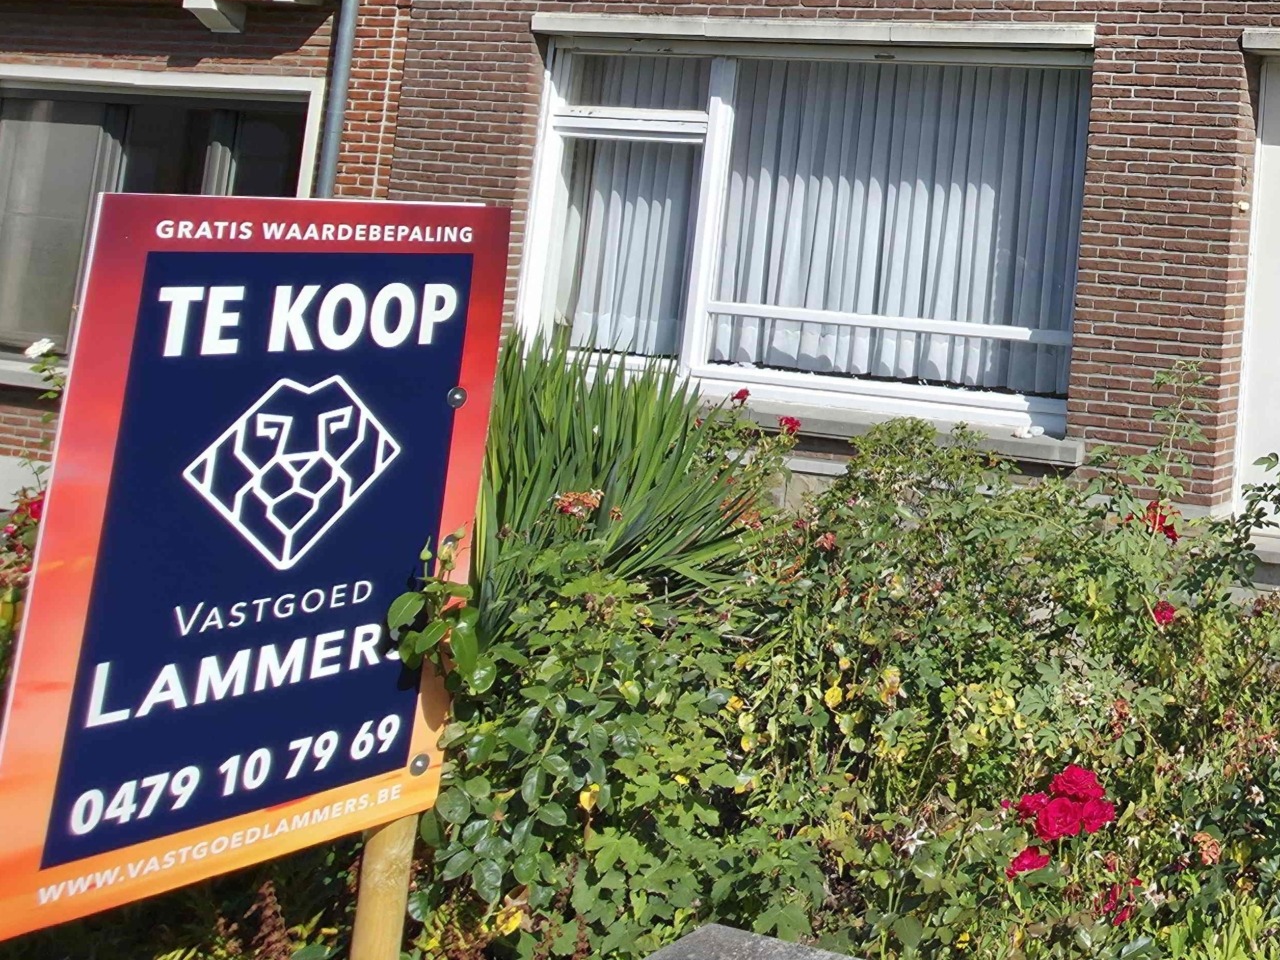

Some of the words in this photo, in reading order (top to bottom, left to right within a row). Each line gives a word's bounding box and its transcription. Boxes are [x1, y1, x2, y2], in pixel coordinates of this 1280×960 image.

[155, 220, 253, 239] GRATIS
[262, 222, 474, 243] WAARDEBEPALING
[158, 286, 245, 357] TE
[267, 282, 458, 352] KOOP
[174, 580, 373, 636] VASTGOED
[85, 623, 401, 728] LAMMER
[70, 766, 200, 836] 0479
[217, 748, 271, 797] 10
[284, 730, 338, 780] 79
[350, 713, 401, 760] 69
[37, 784, 403, 906] WWW.VASTGOEDLAMMERS.BE
